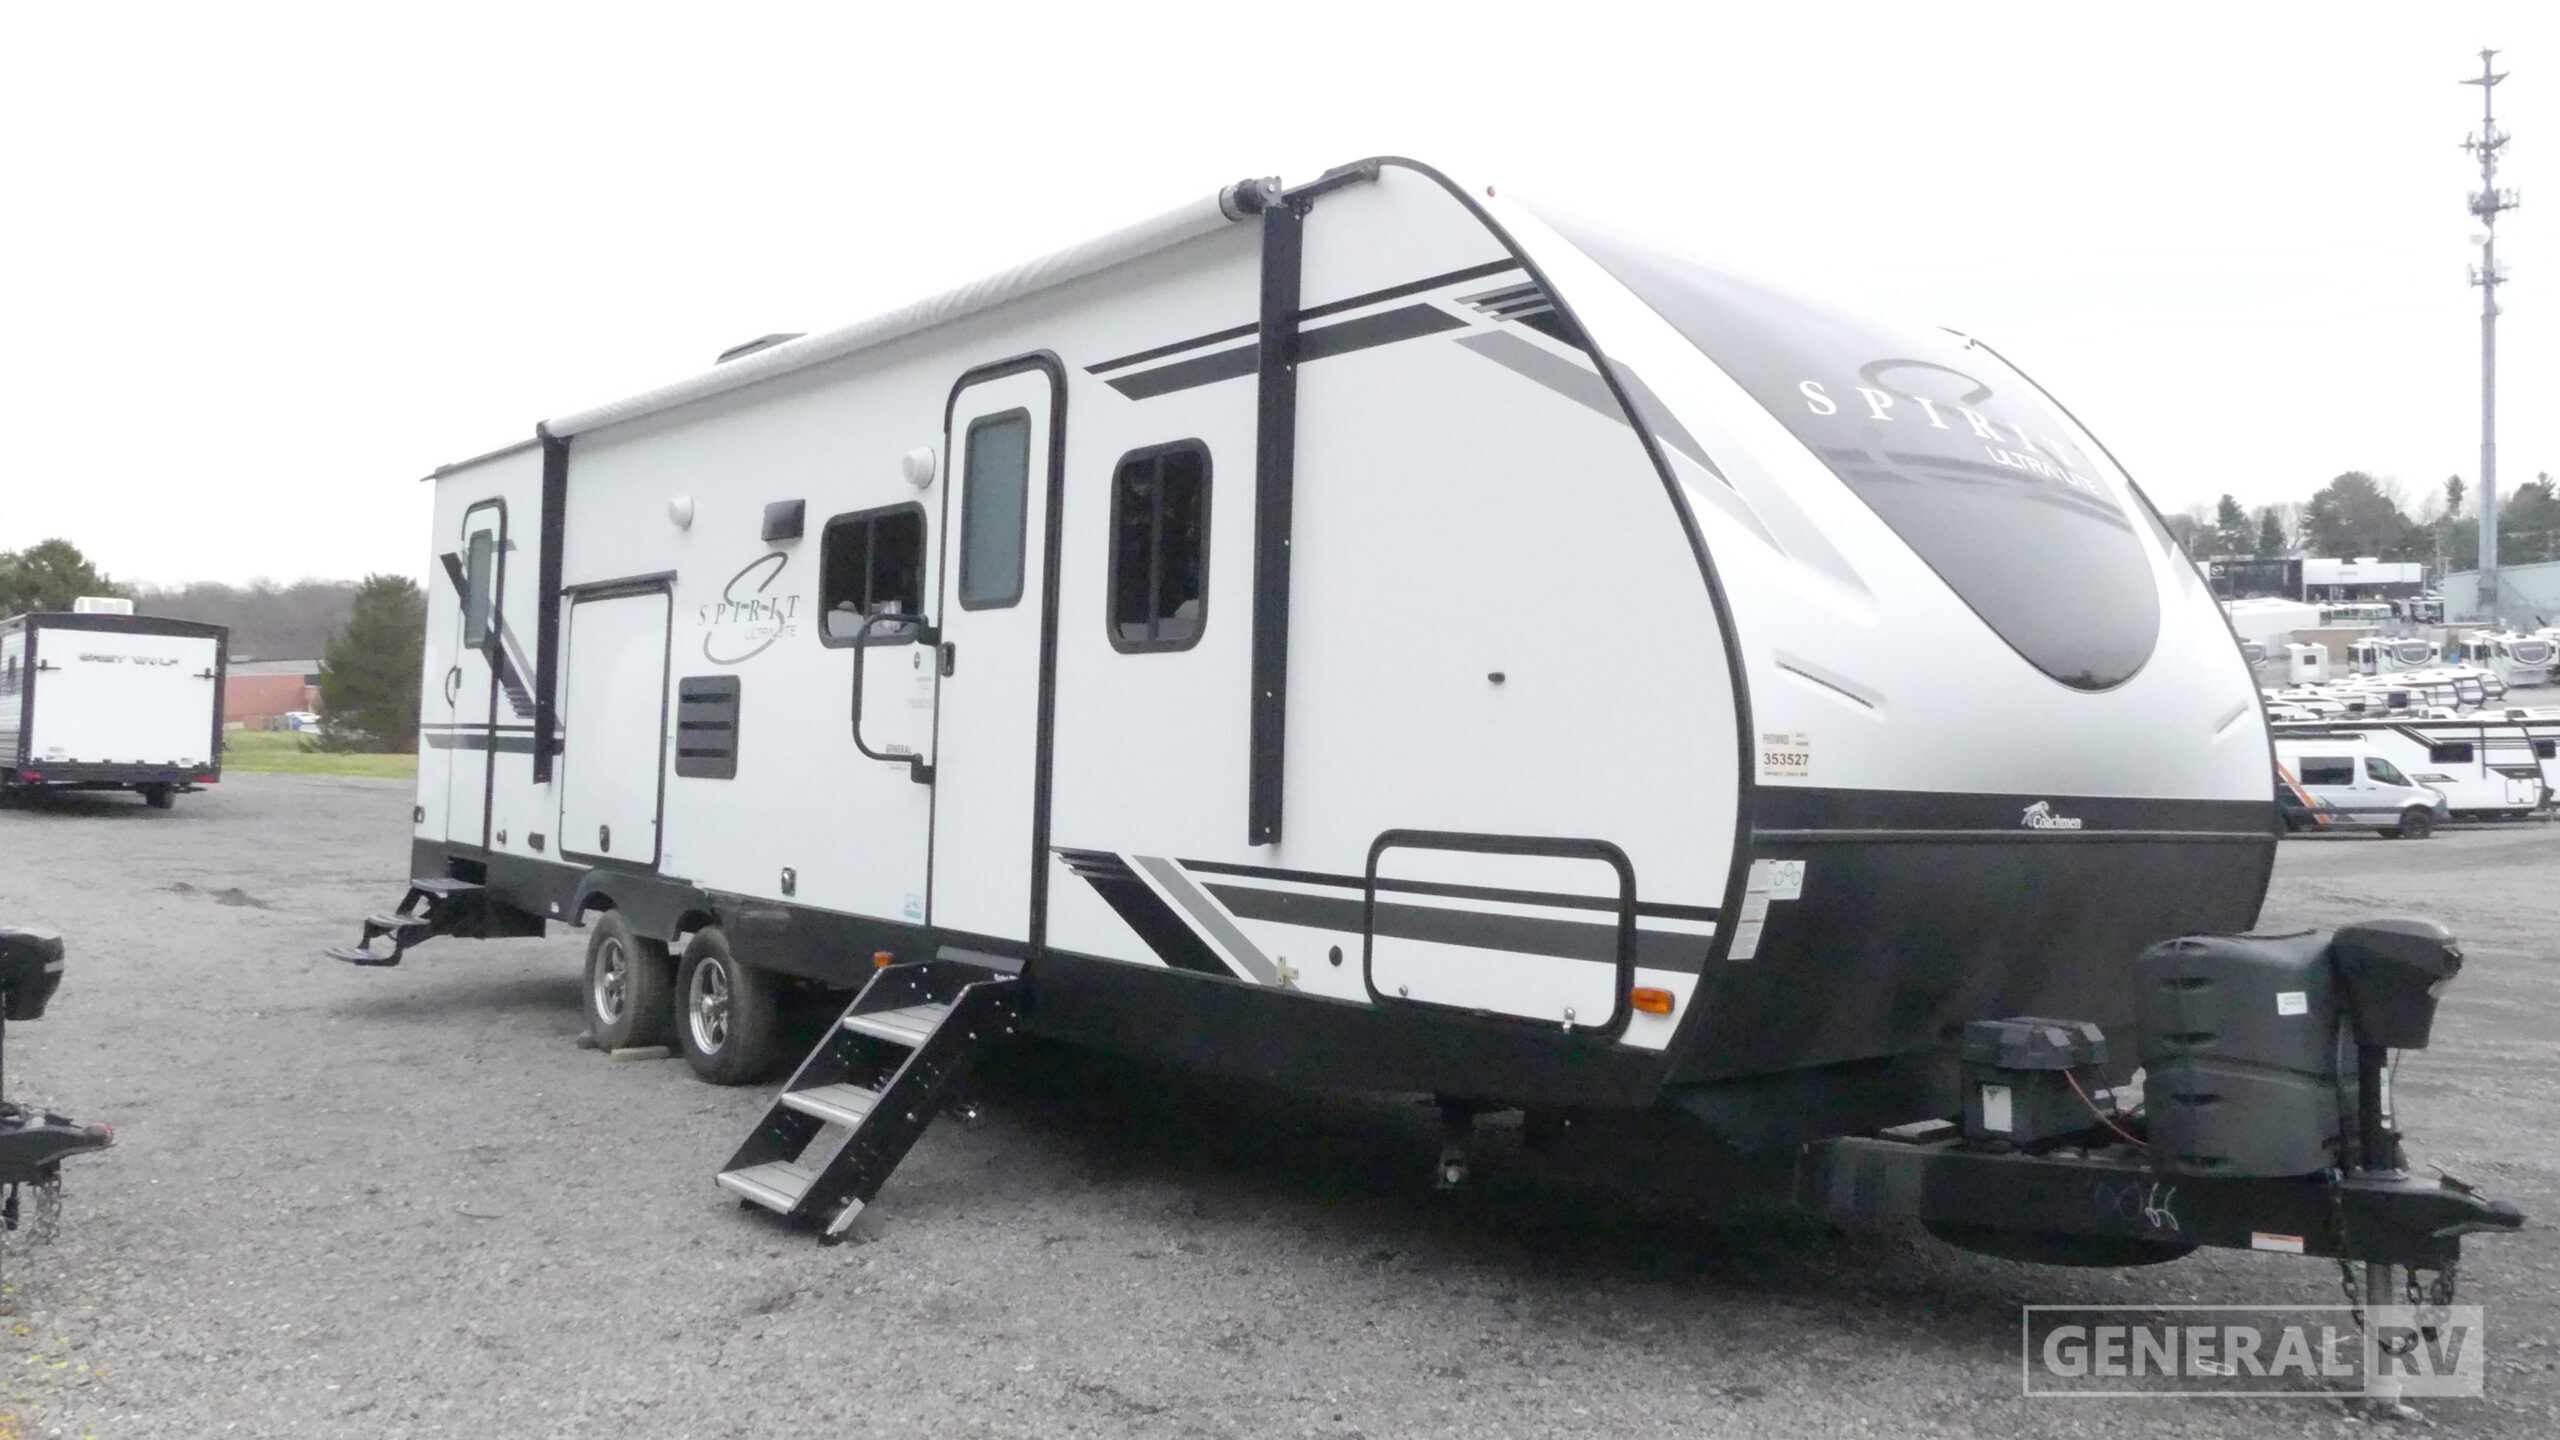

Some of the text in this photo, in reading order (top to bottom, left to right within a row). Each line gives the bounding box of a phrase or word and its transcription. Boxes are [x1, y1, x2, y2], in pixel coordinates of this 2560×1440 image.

[1799, 381, 2075, 467] SPIRIT
[697, 595, 800, 626] SPIRIT
[1764, 752, 1809, 766] 353527
[2033, 814, 2082, 829] Coachmen
